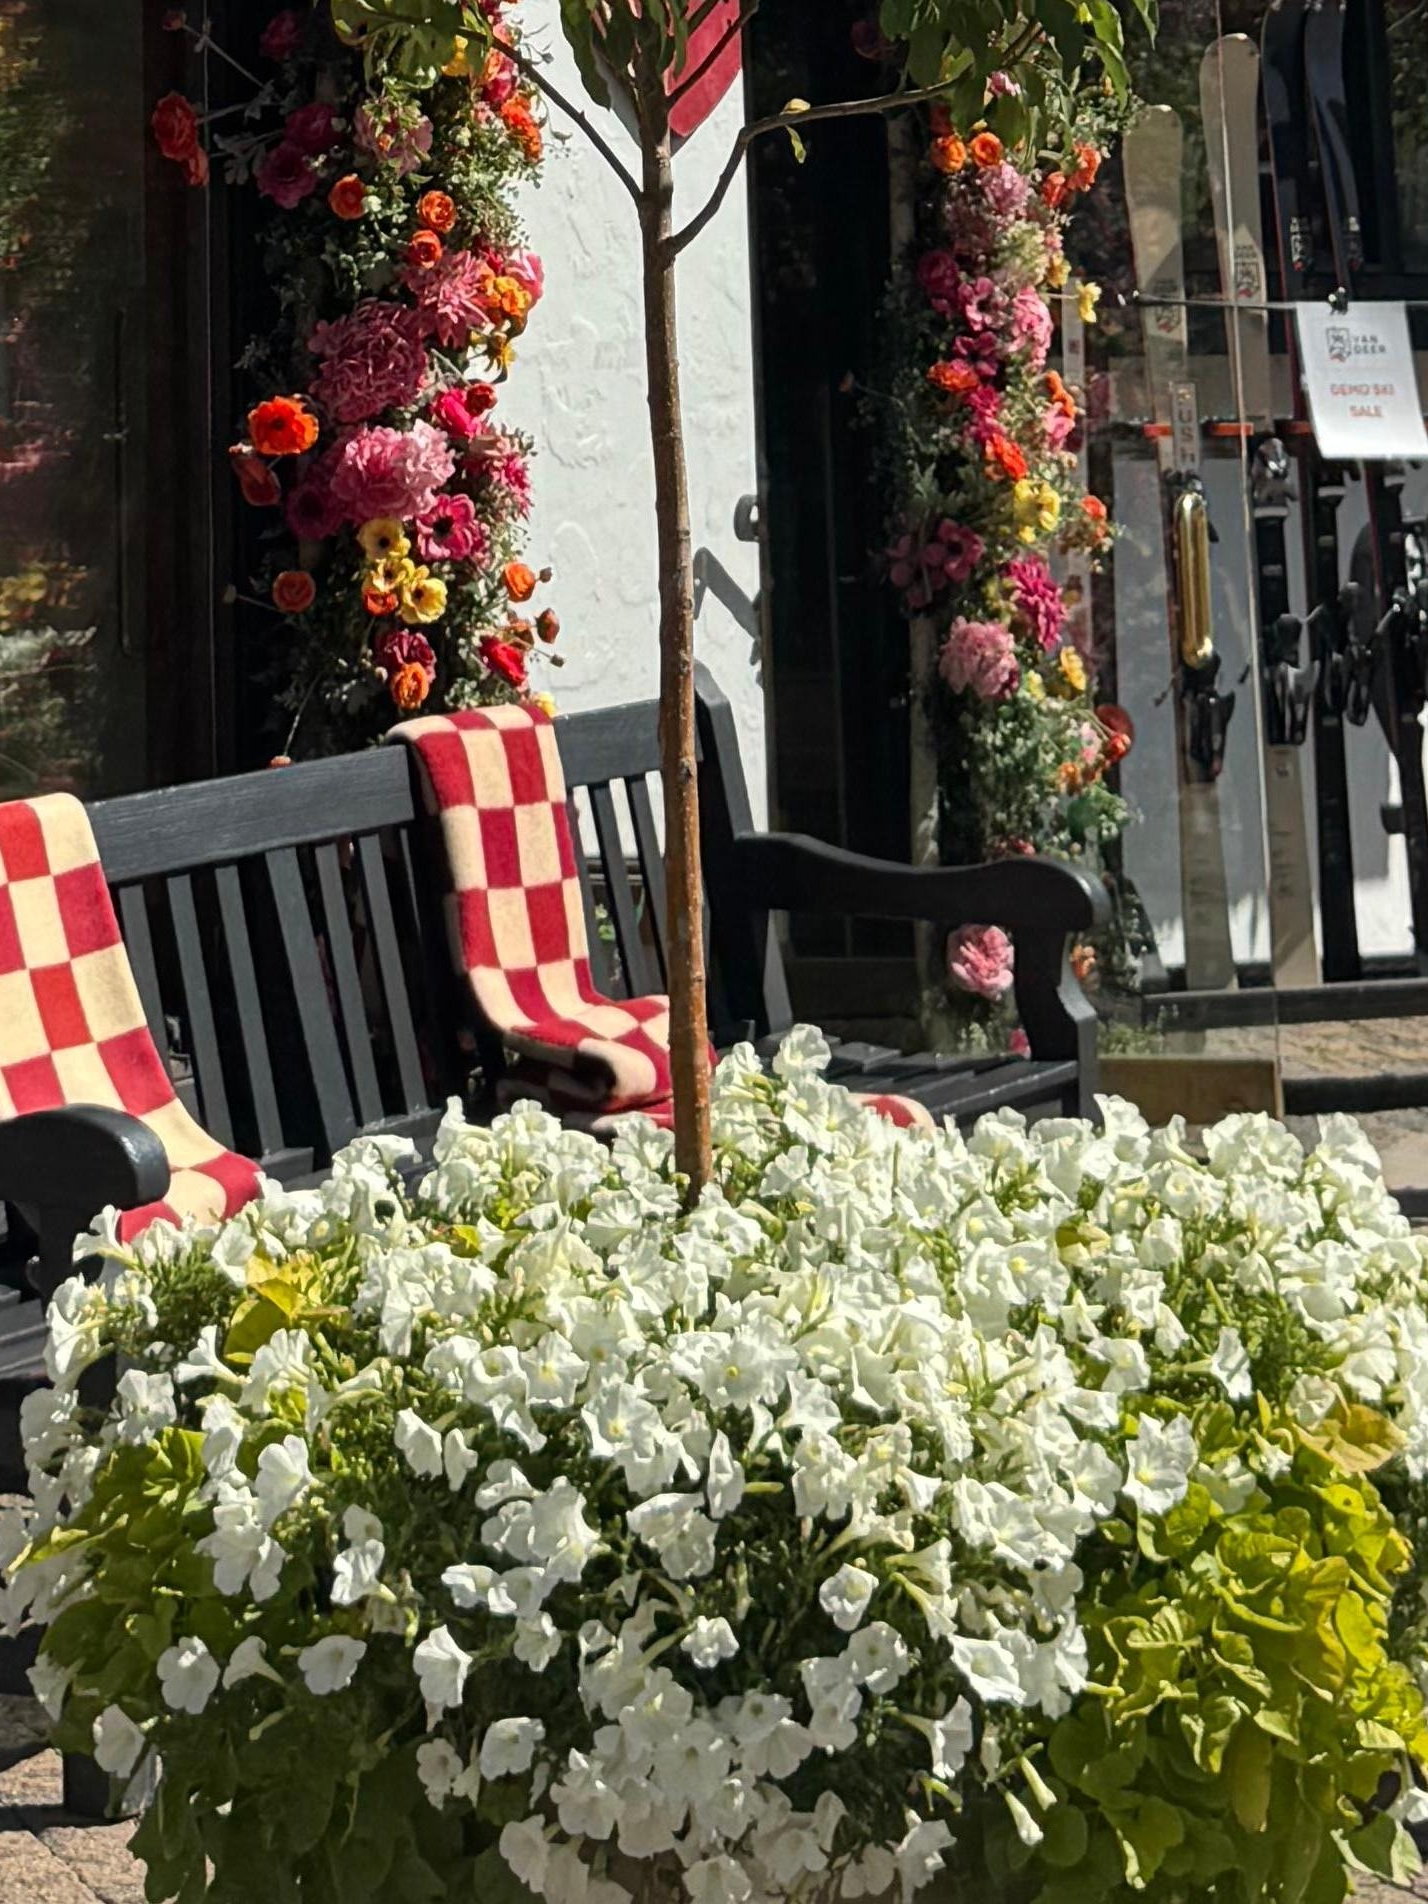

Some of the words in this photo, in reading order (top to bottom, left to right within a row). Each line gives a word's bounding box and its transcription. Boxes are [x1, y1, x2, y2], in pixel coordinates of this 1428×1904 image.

[1354, 335, 1378, 343] VAN
[1354, 344, 1386, 354] DEER
[1330, 383, 1370, 396] DEMO
[1372, 383, 1395, 396] SKI
[1349, 405, 1382, 418] SALE
